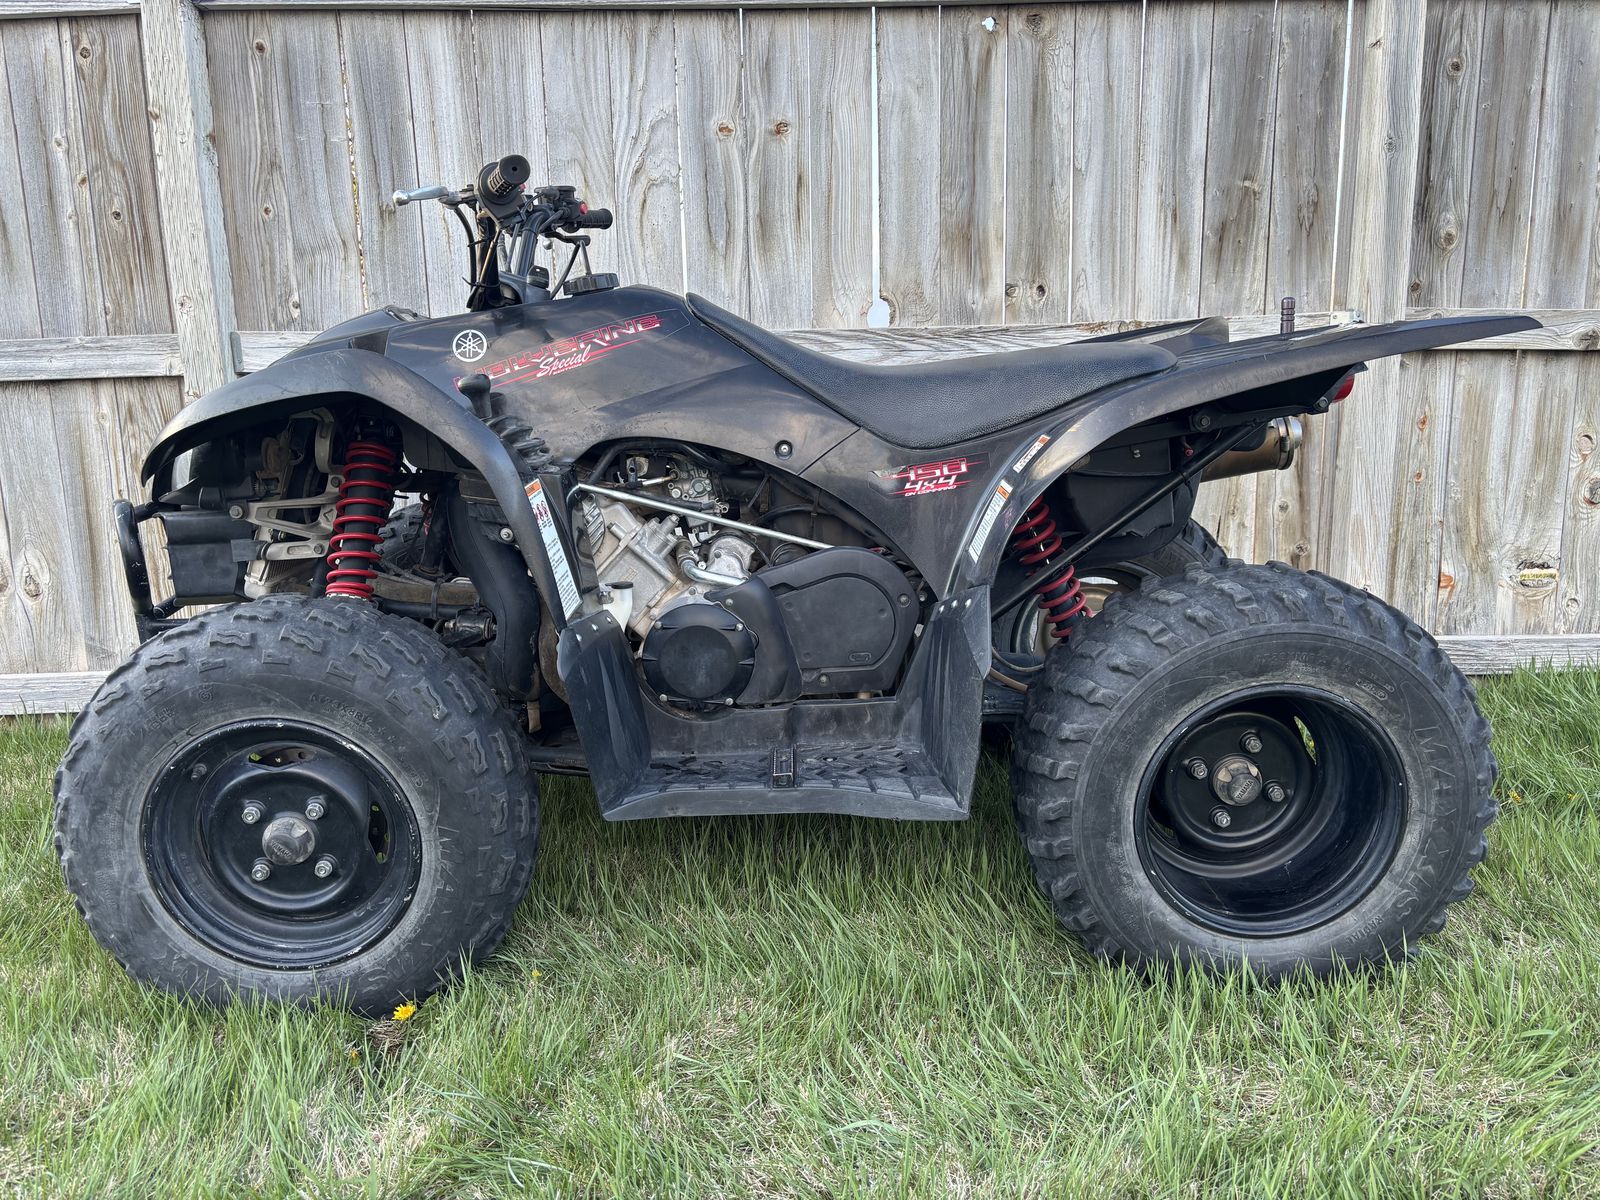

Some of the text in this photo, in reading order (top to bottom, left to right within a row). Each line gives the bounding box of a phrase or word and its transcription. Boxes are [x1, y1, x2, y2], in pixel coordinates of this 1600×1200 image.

[453, 314, 661, 392] OLVERINE
[536, 344, 592, 378] Special
[904, 475, 957, 491] 4x4
[1234, 780, 1254, 800] YAMAHA
